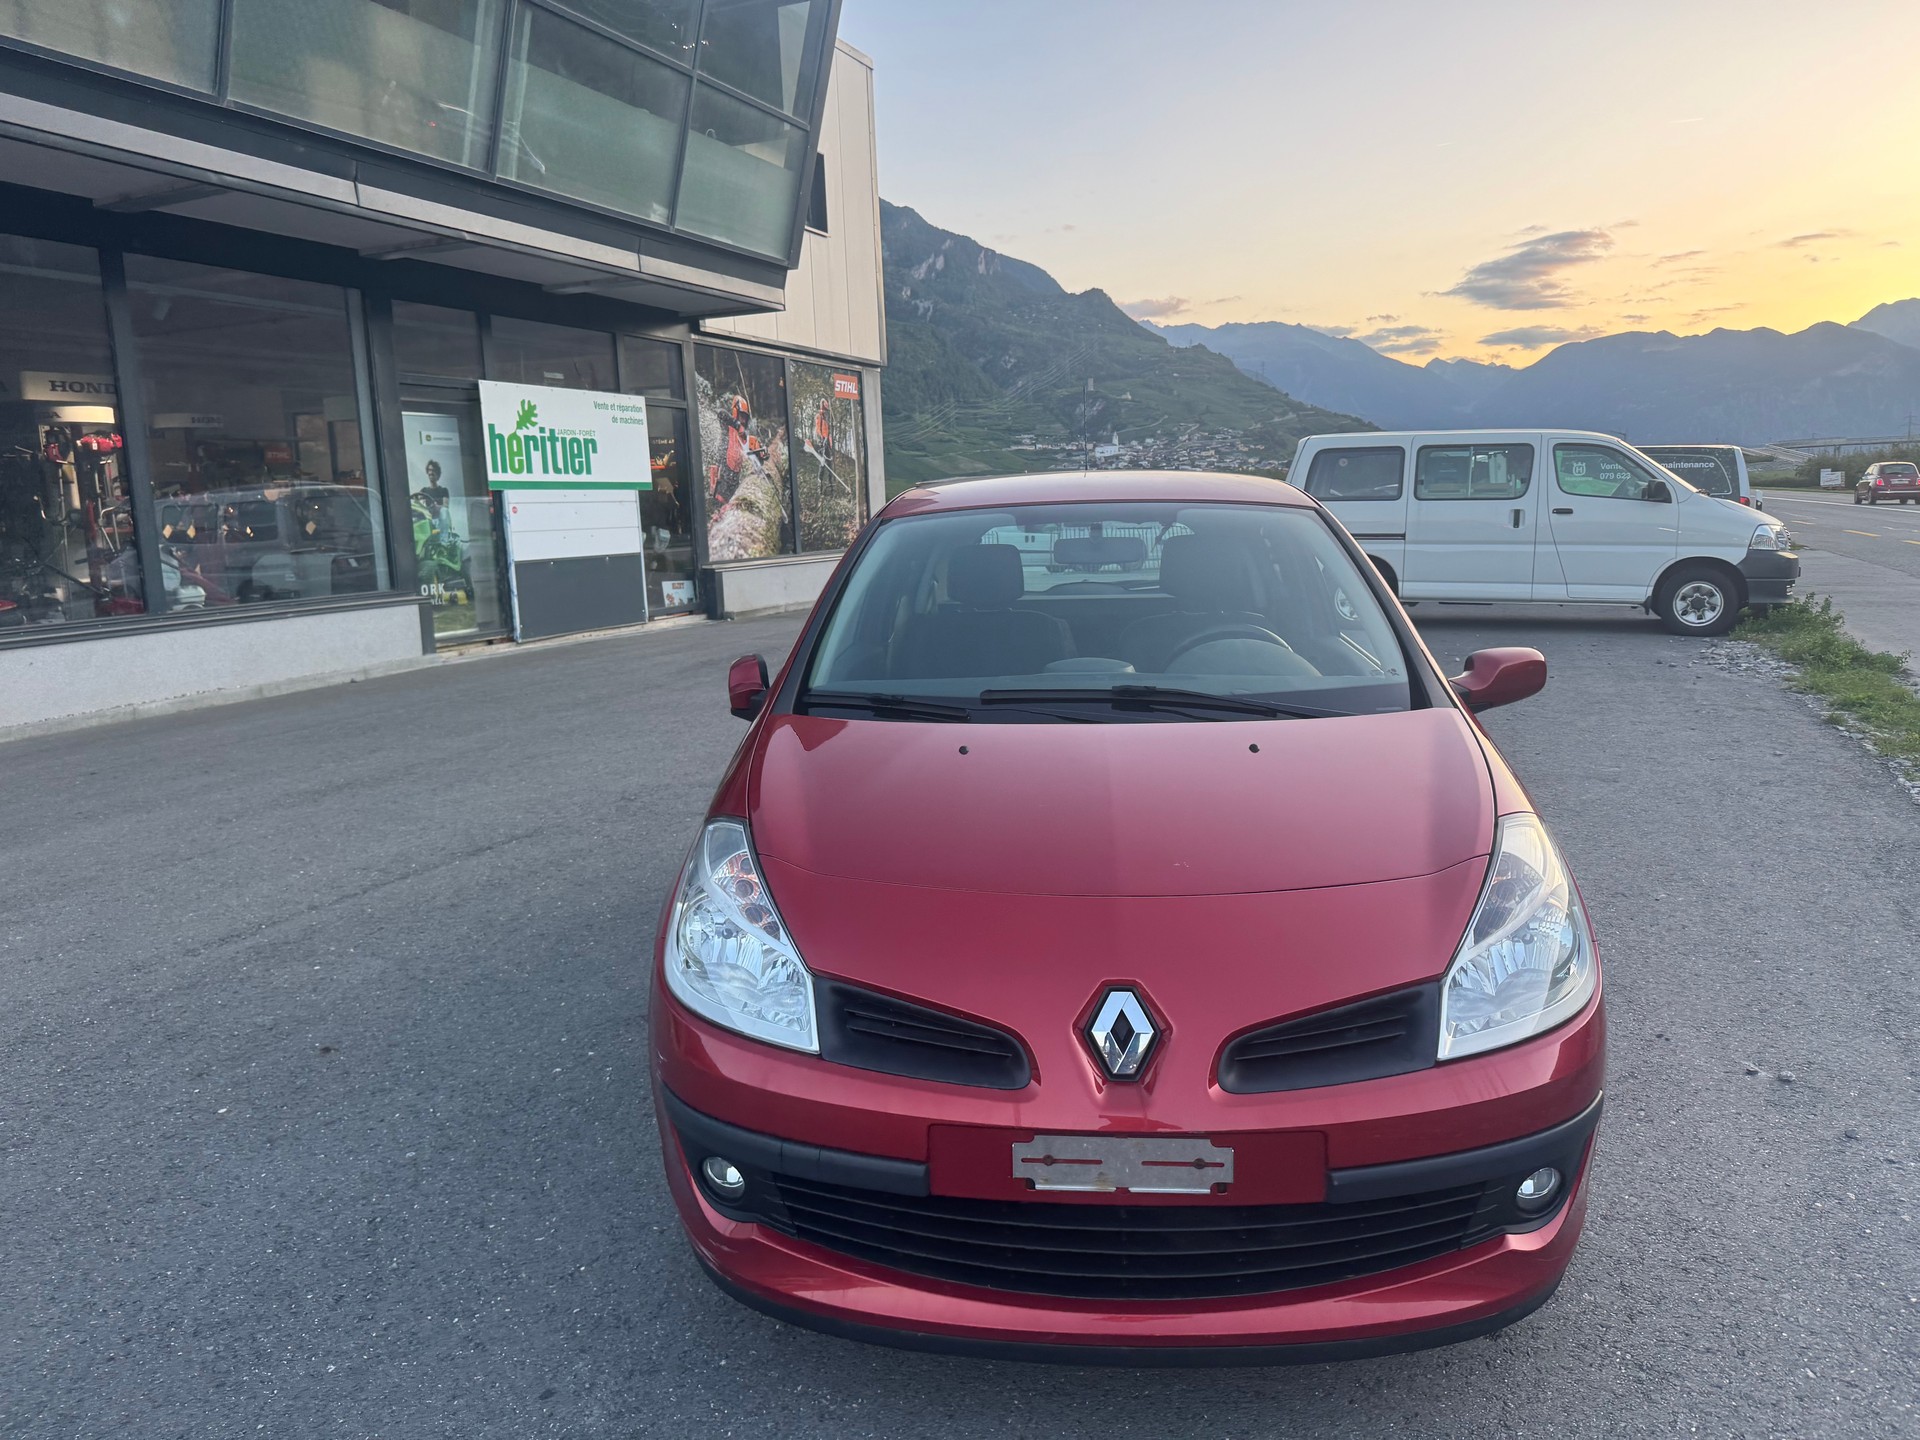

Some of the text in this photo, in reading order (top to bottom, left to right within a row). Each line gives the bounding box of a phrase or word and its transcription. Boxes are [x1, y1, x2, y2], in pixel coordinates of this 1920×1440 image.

[835, 379, 858, 394] STIHL
[593, 400, 643, 413] Vente et réparation
[611, 415, 644, 425] de machines
[1600, 461, 1716, 470] Vente maintenance
[1599, 472, 1615, 480] 079
